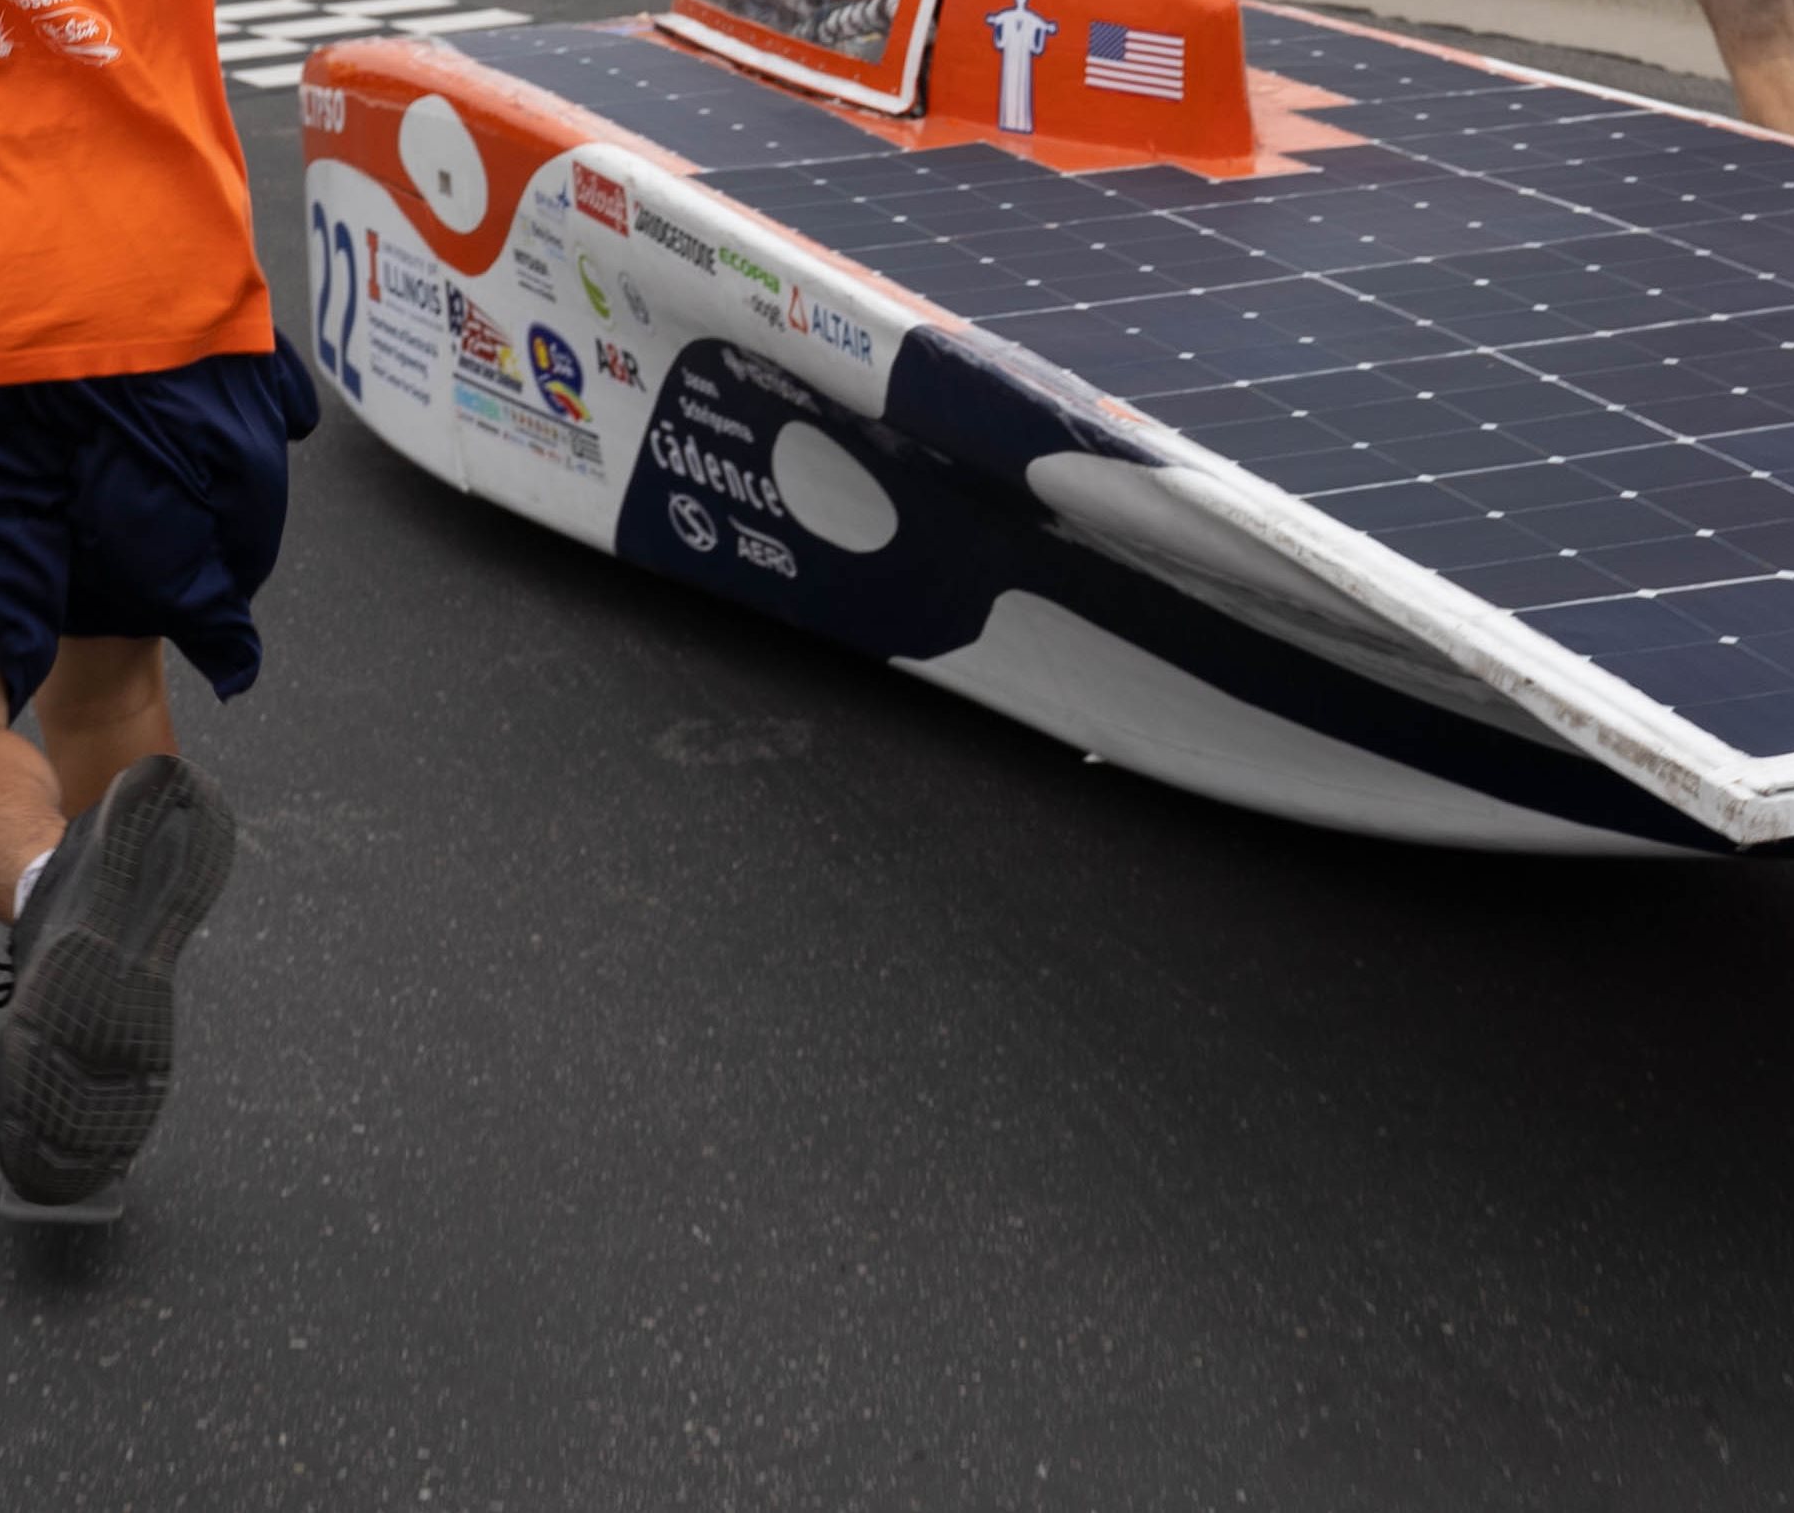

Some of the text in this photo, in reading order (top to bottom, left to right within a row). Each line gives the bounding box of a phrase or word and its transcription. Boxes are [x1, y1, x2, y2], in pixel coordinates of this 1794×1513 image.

[312, 199, 363, 404] 22
[383, 260, 442, 316] ILLINOIS
[812, 302, 874, 367] ALTAIR
